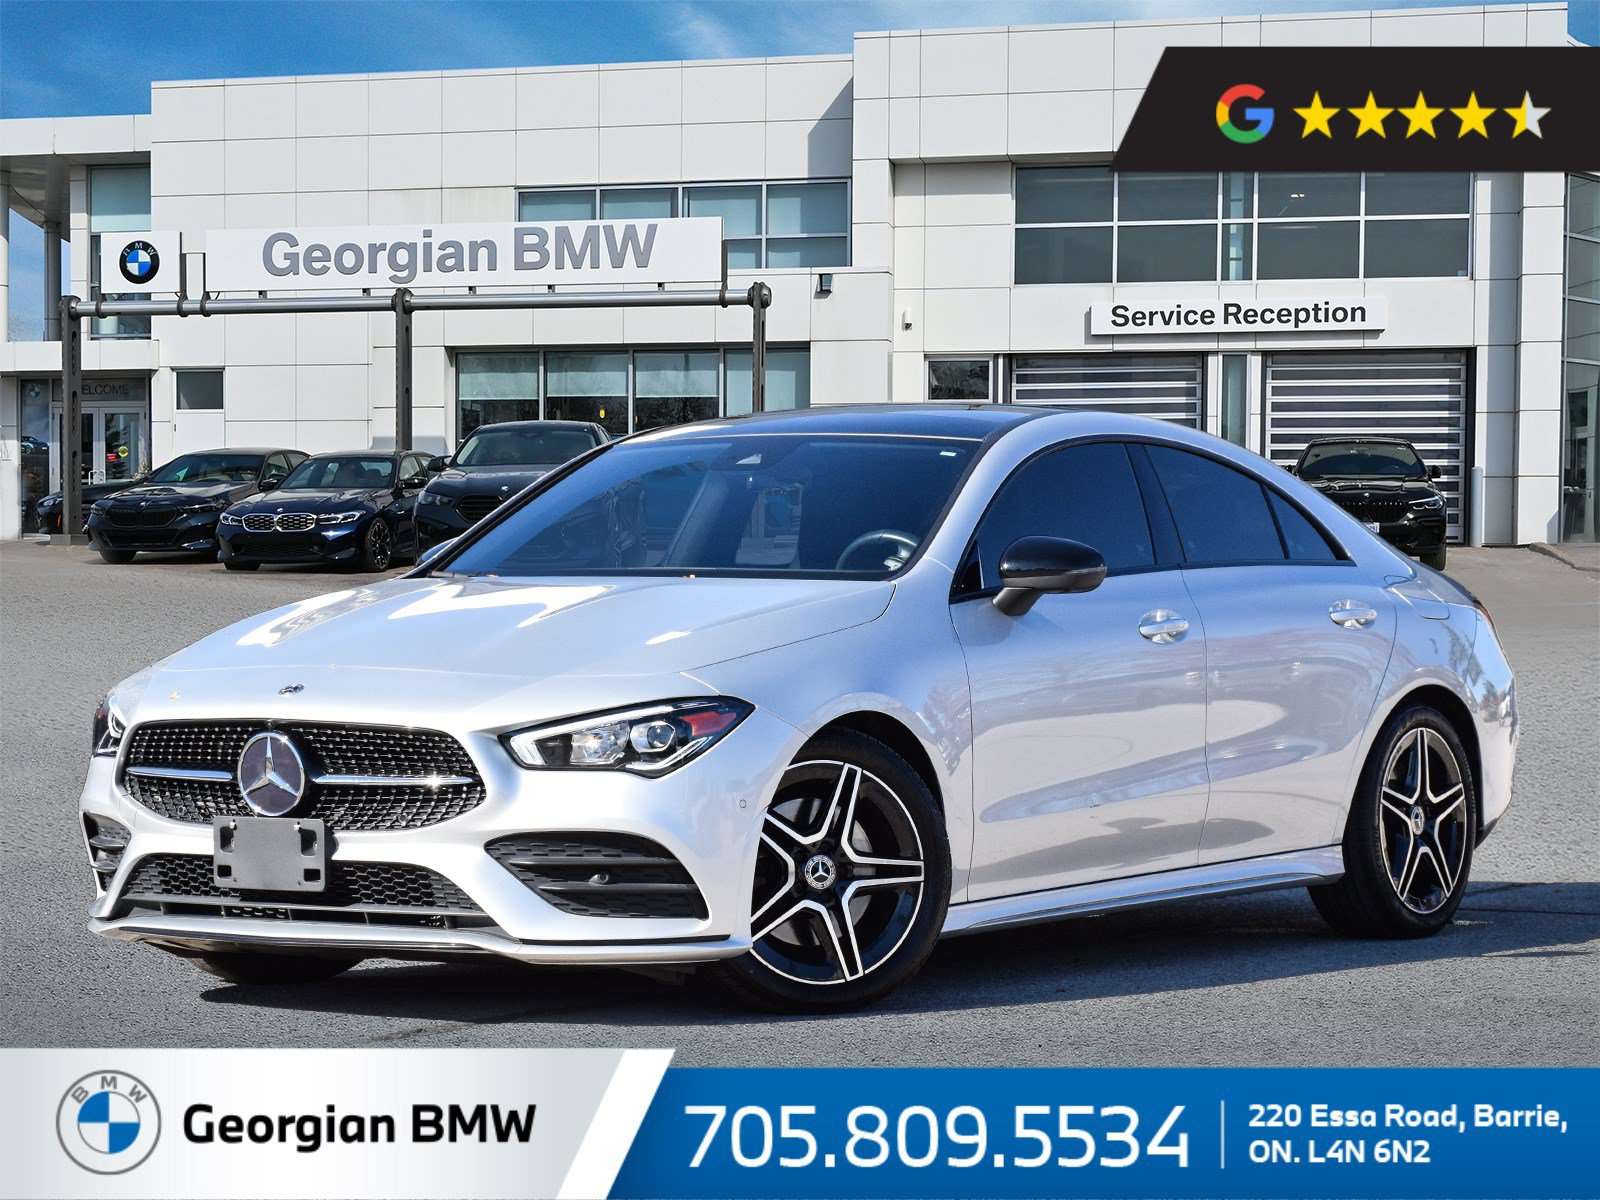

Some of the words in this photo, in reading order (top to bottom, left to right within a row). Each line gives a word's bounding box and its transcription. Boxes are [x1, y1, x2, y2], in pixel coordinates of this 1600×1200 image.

[122, 242, 157, 256] BMW
[262, 229, 498, 285] Georgian
[513, 224, 659, 272] BMW
[1110, 304, 1216, 328] Service
[1223, 301, 1366, 329] Reception
[80, 383, 129, 395] ELCOME
